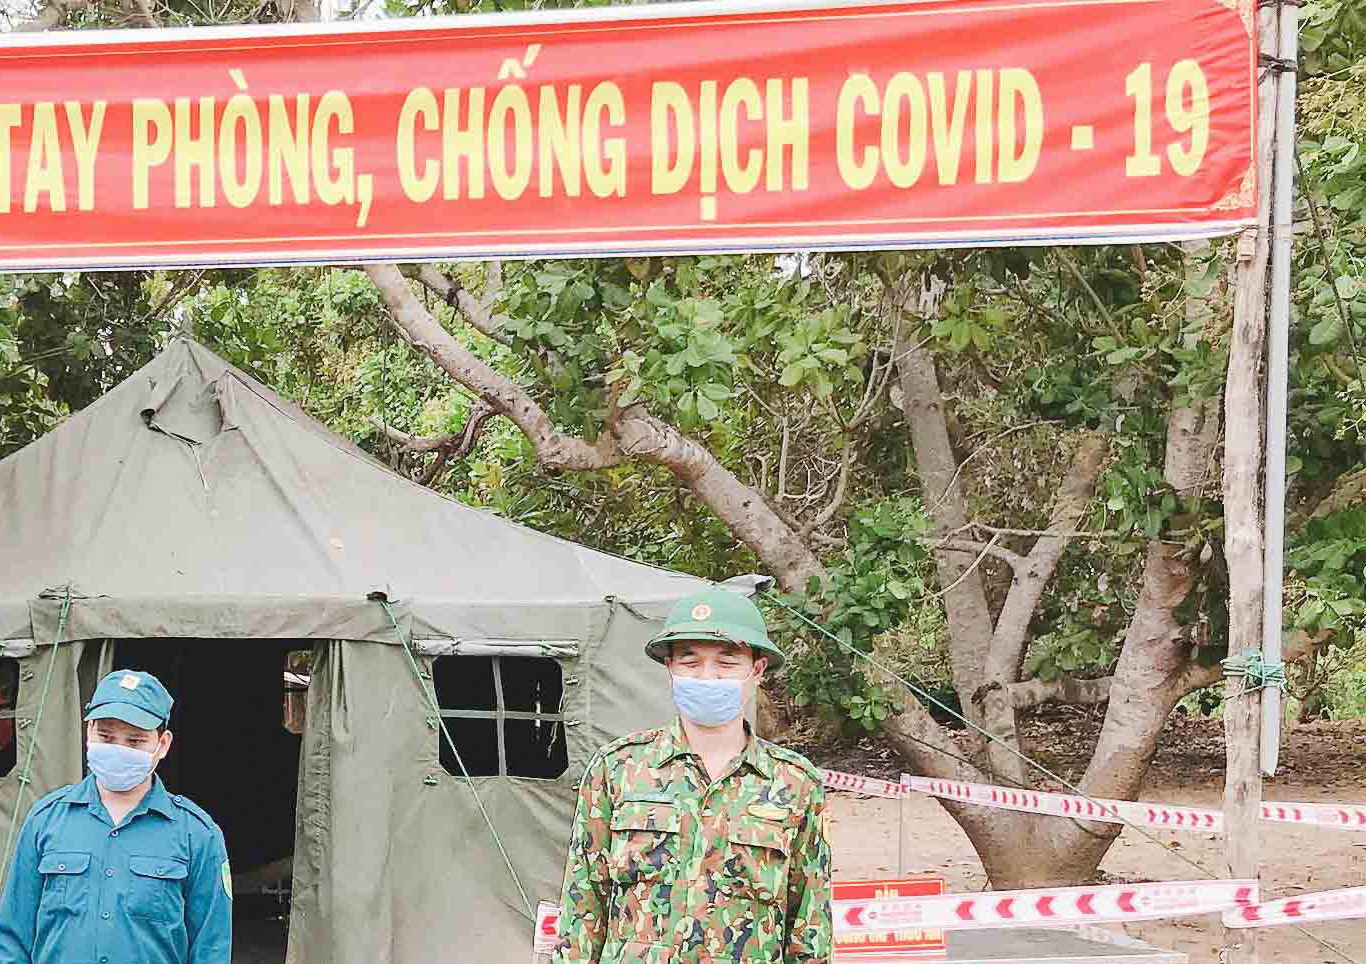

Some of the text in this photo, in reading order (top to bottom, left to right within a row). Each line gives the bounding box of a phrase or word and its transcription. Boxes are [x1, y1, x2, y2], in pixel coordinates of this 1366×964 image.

[132, 69, 374, 228] PHÒNG,
[396, 43, 628, 204] CHỐNG
[651, 77, 810, 220] DỊCH
[836, 67, 1044, 191] COVID
[1125, 57, 1211, 178] 19
